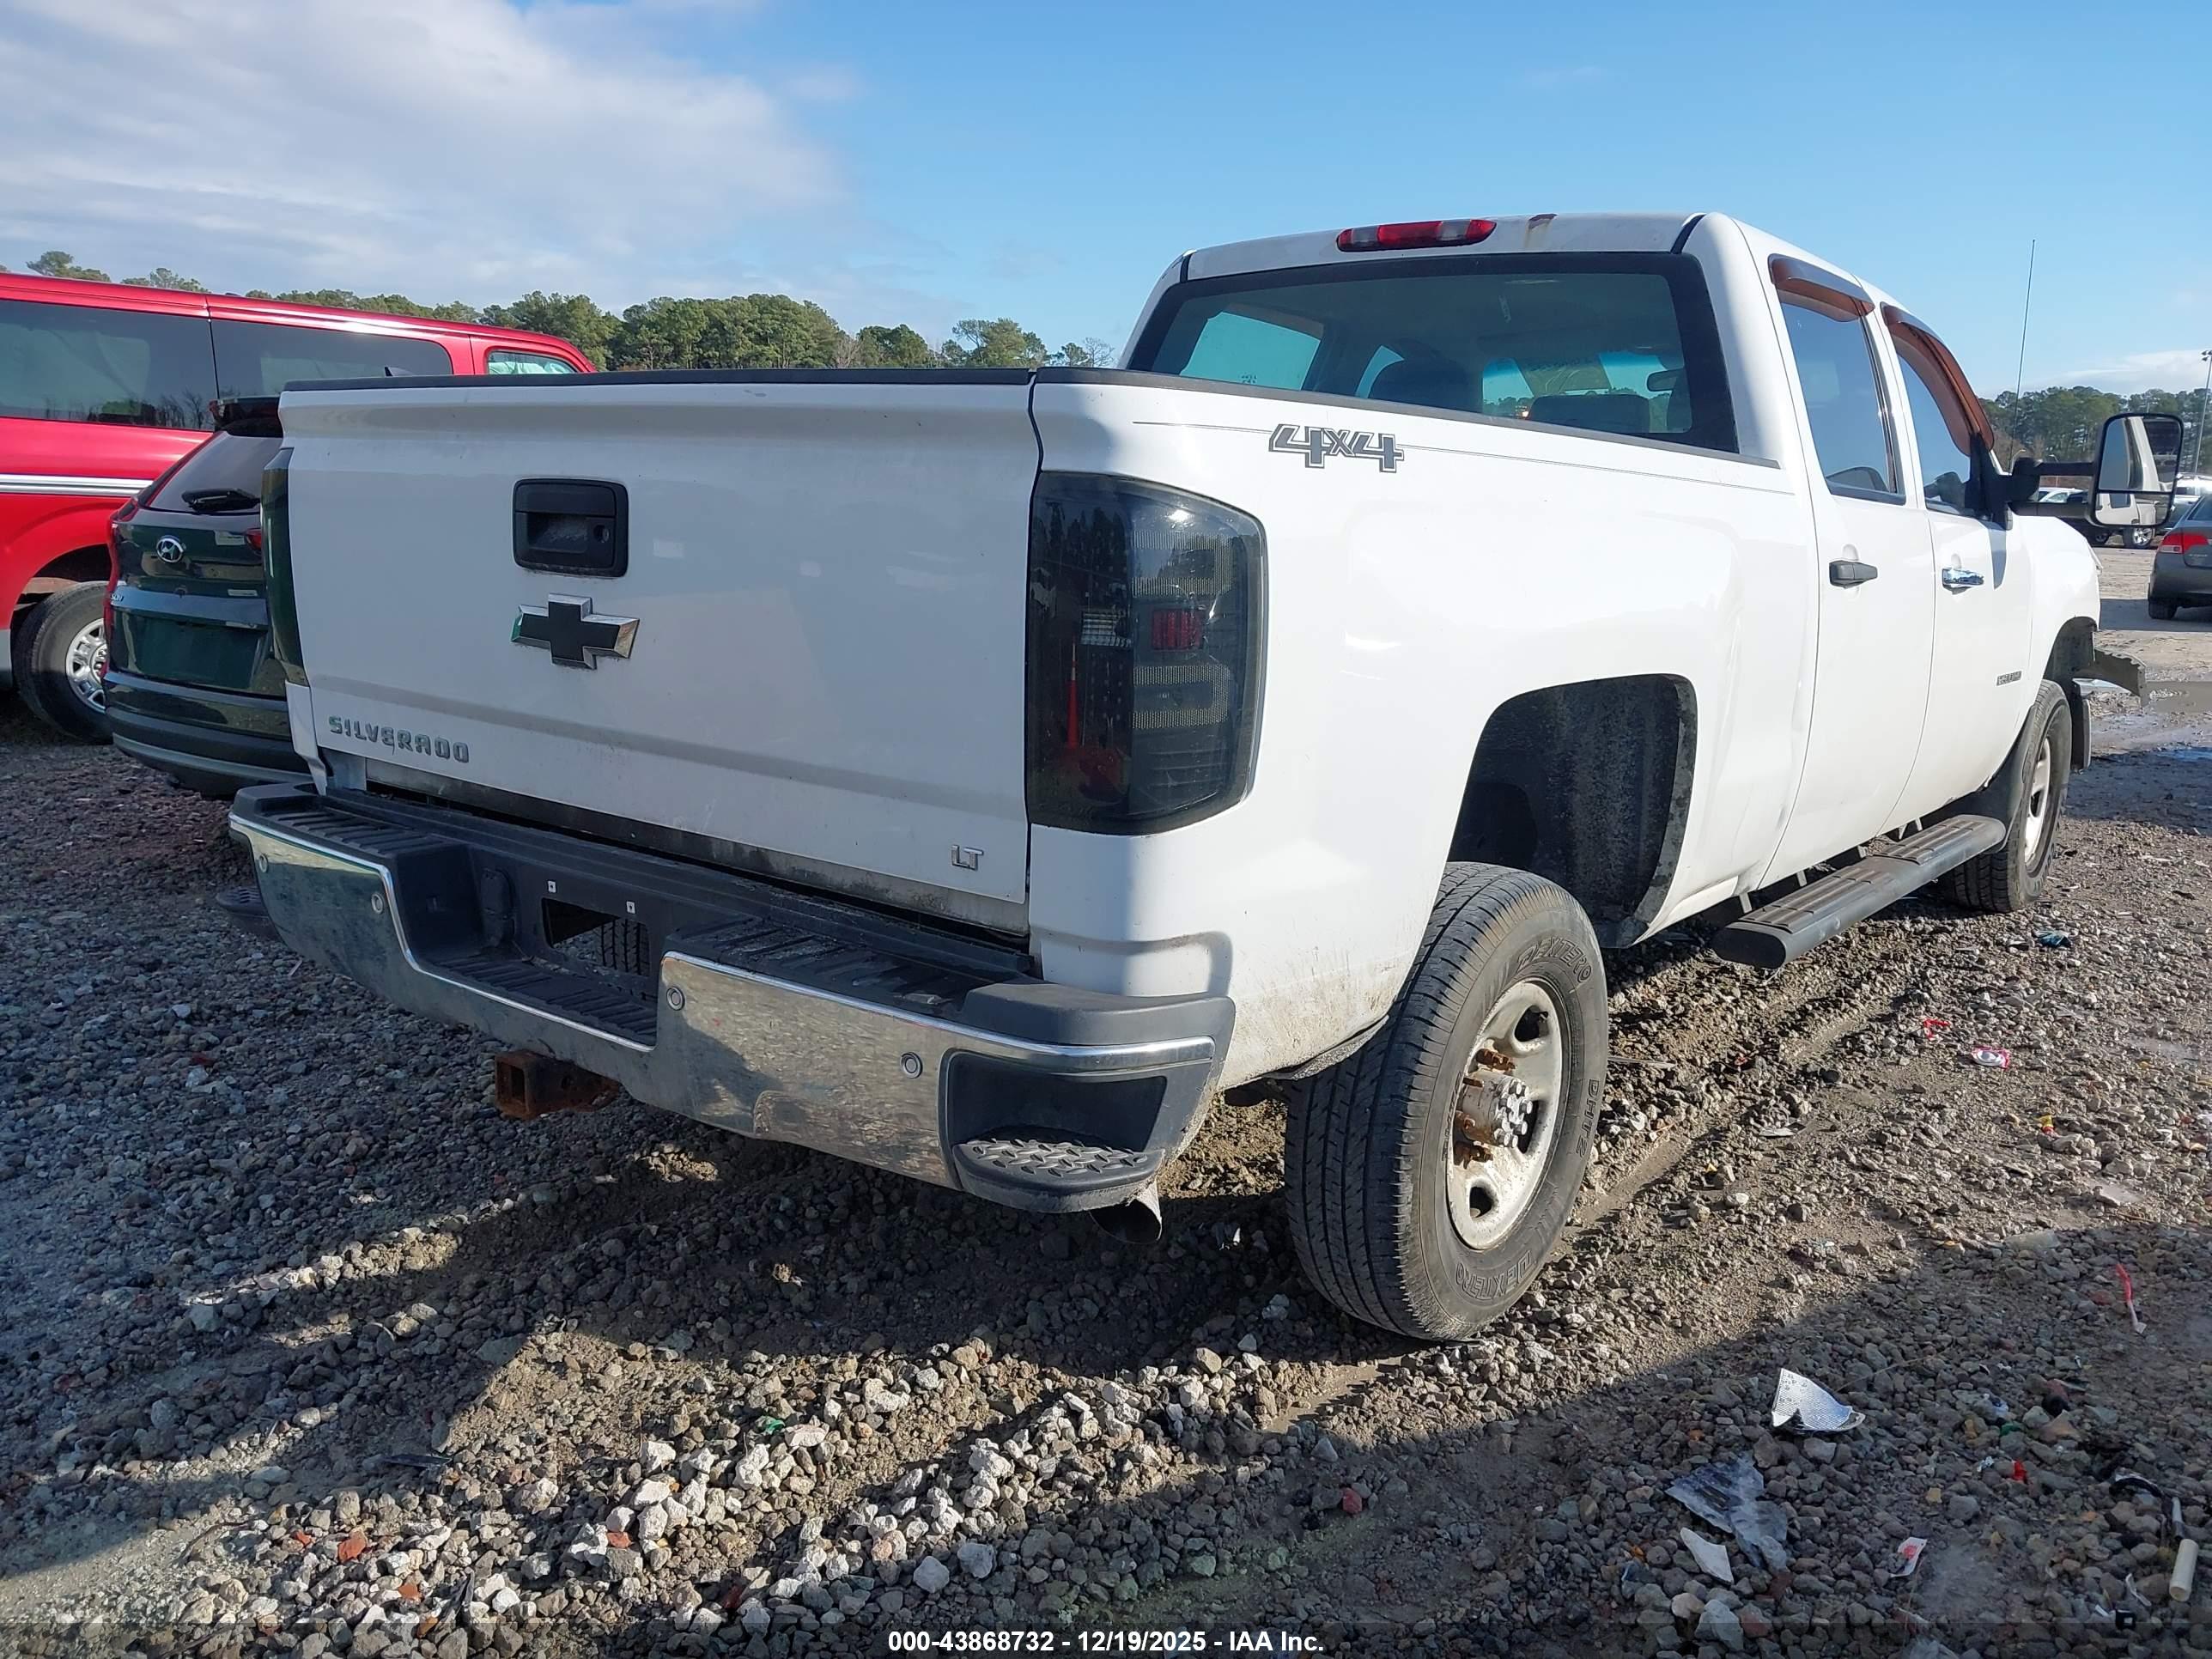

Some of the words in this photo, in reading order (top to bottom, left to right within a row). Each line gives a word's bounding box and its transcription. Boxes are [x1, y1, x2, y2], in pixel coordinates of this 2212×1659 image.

[328, 715, 470, 763] SILVERADO
[951, 844, 984, 872] LT
[1516, 936, 1592, 983] DEXTERO
[1576, 1079, 1600, 1158] DHT2
[1455, 1250, 1532, 1301] DEXTERO
